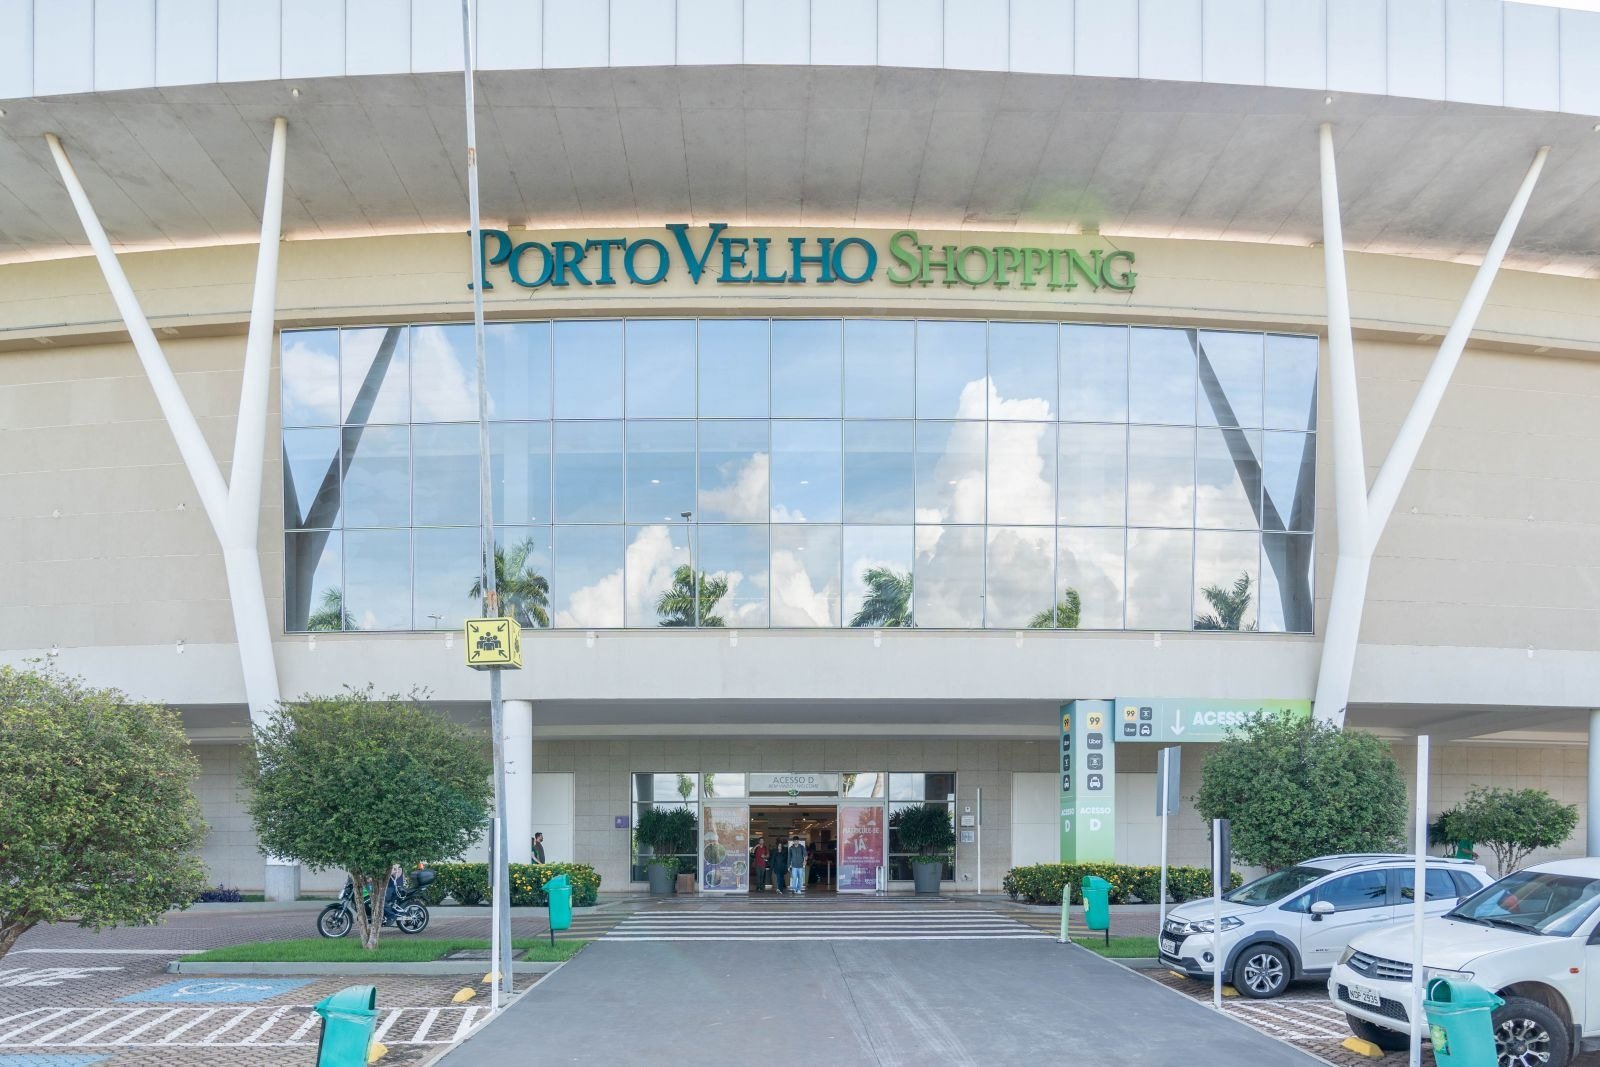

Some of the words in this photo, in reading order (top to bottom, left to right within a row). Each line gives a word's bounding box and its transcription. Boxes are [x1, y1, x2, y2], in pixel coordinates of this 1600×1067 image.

[887, 231, 1138, 293] SHOPPING
[1089, 716, 1101, 726] 99
[772, 776, 806, 784] ACESSO
[1089, 818, 1102, 831] D
